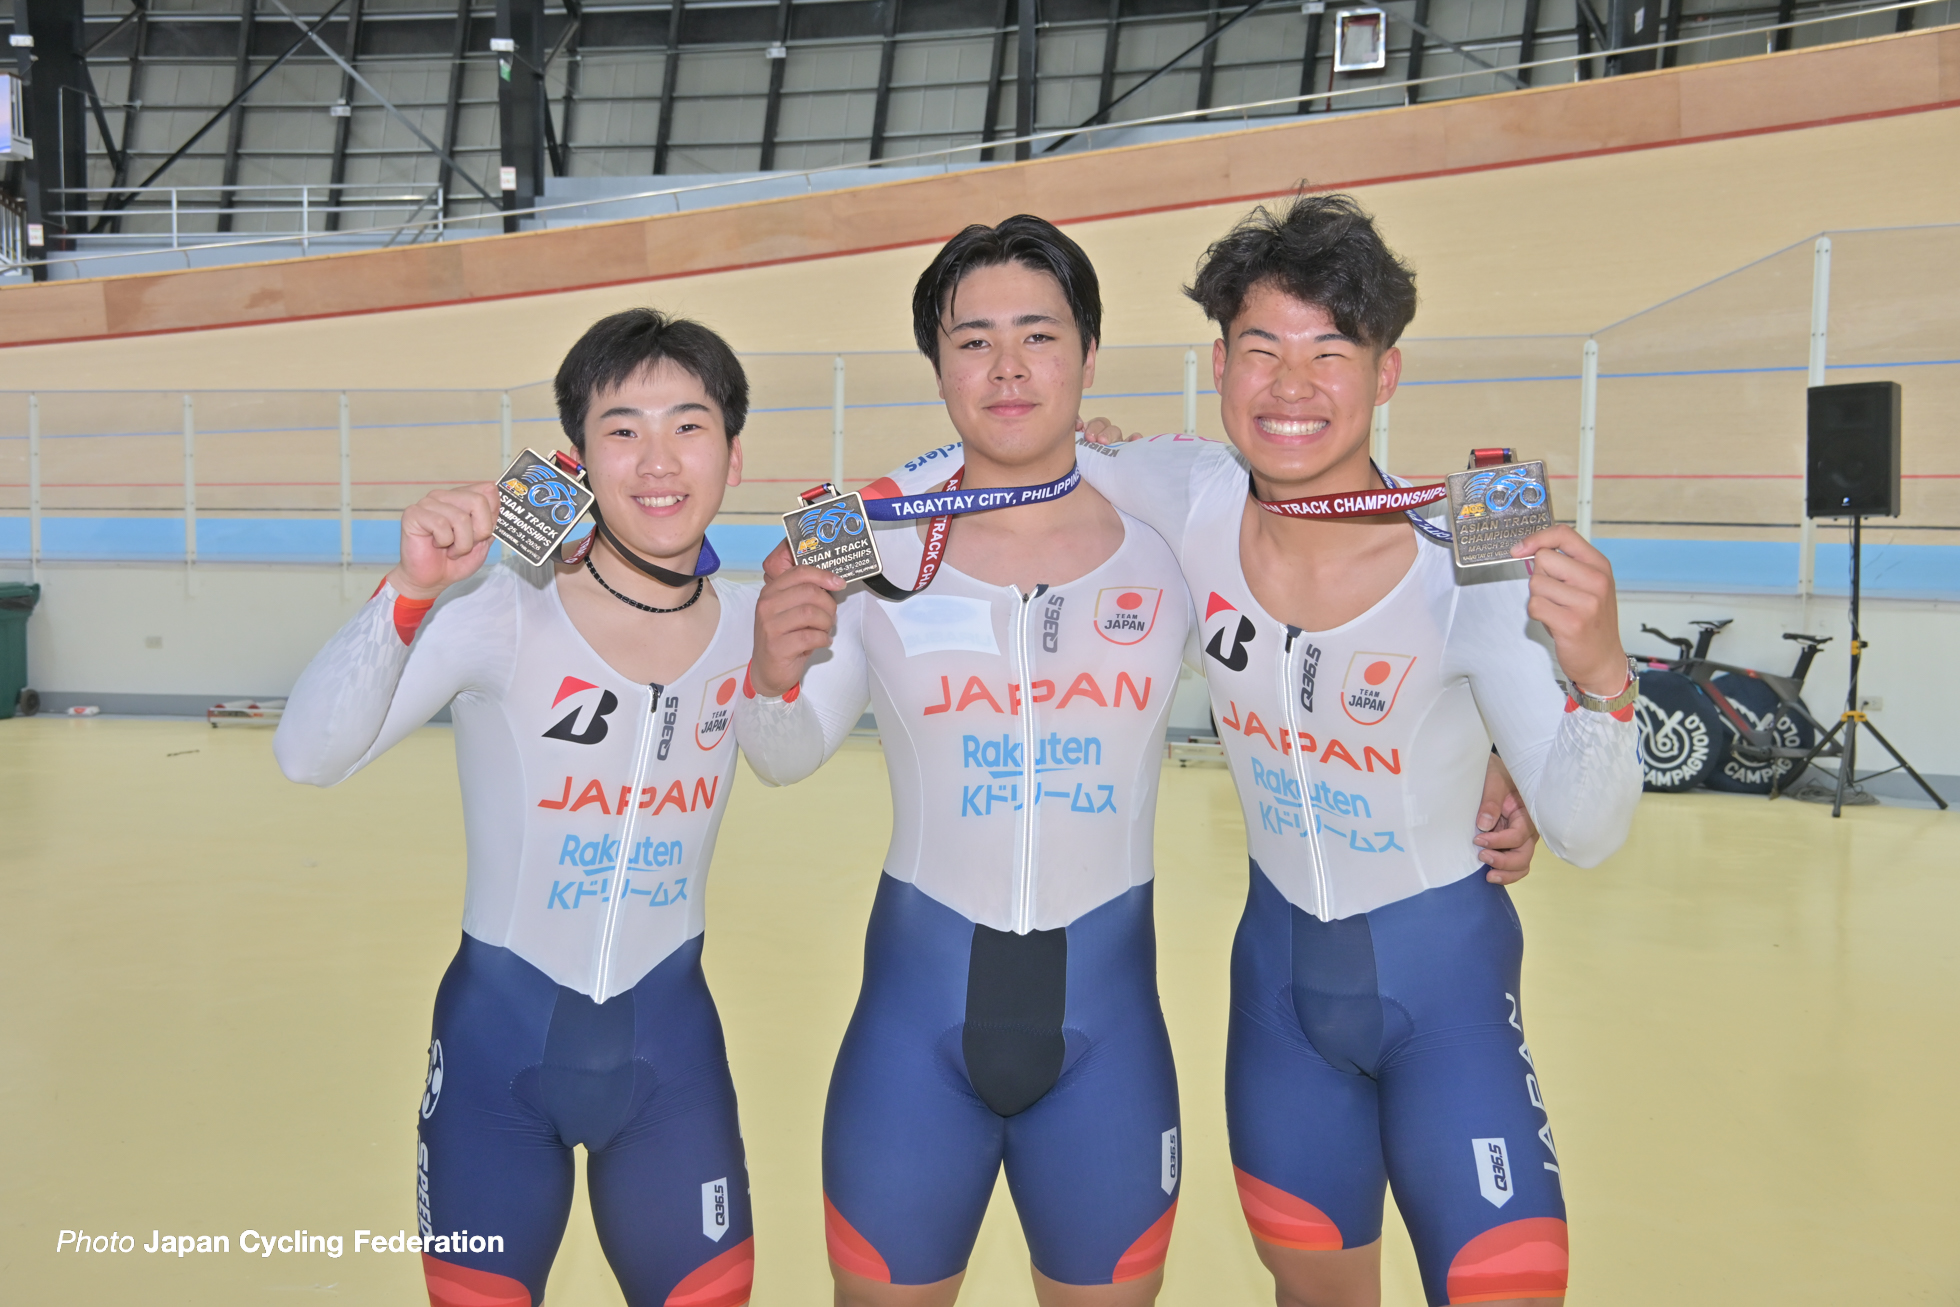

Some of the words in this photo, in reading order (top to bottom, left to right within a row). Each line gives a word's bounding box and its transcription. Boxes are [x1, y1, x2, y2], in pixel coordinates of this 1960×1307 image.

[904, 441, 963, 472] clers
[1075, 438, 1120, 457] KEIRIN
[892, 495, 974, 516] TAGAYTAY
[978, 492, 1016, 506] CITY,
[1021, 466, 1080, 501] PHILIPPINE
[1281, 502, 1332, 515] TRACK
[1333, 486, 1447, 513] CHAMPIONSHIPS
[497, 516, 509, 527] RCH
[499, 506, 552, 547] AMPIONSHIPS
[525, 512, 558, 539] TRACK
[926, 515, 948, 561] TRACK
[1460, 520, 1499, 534] ASIAN
[1503, 512, 1547, 528] TRACK
[802, 551, 831, 566] ASIAN
[834, 538, 869, 555] TRACK
[816, 547, 872, 570] AMPIONSHIPS
[1042, 594, 1064, 654] Q36.5
[1104, 619, 1145, 632] JAPAN
[923, 671, 1152, 716] JAPAN
[1300, 643, 1322, 713] Q36.5
[1359, 688, 1380, 698] TEAM
[712, 710, 727, 719] TEAM
[1348, 694, 1386, 712] JAPAN
[657, 696, 679, 761] Q36.5
[701, 717, 728, 734] JAPAN
[1222, 700, 1402, 775] JAPAN
[962, 732, 1102, 769] Rakuten
[1724, 716, 1800, 784] CAMPAGOLO
[537, 775, 719, 816] JAPAN
[961, 781, 1117, 818] Kドリームス
[1250, 756, 1372, 819] Rakuten
[1259, 801, 1405, 853] Kドリームス
[558, 833, 683, 868] Rakuten
[547, 877, 688, 910] Kドリームス
[1488, 1142, 1508, 1192] Q36.5
[714, 1184, 725, 1226] Q36.5
